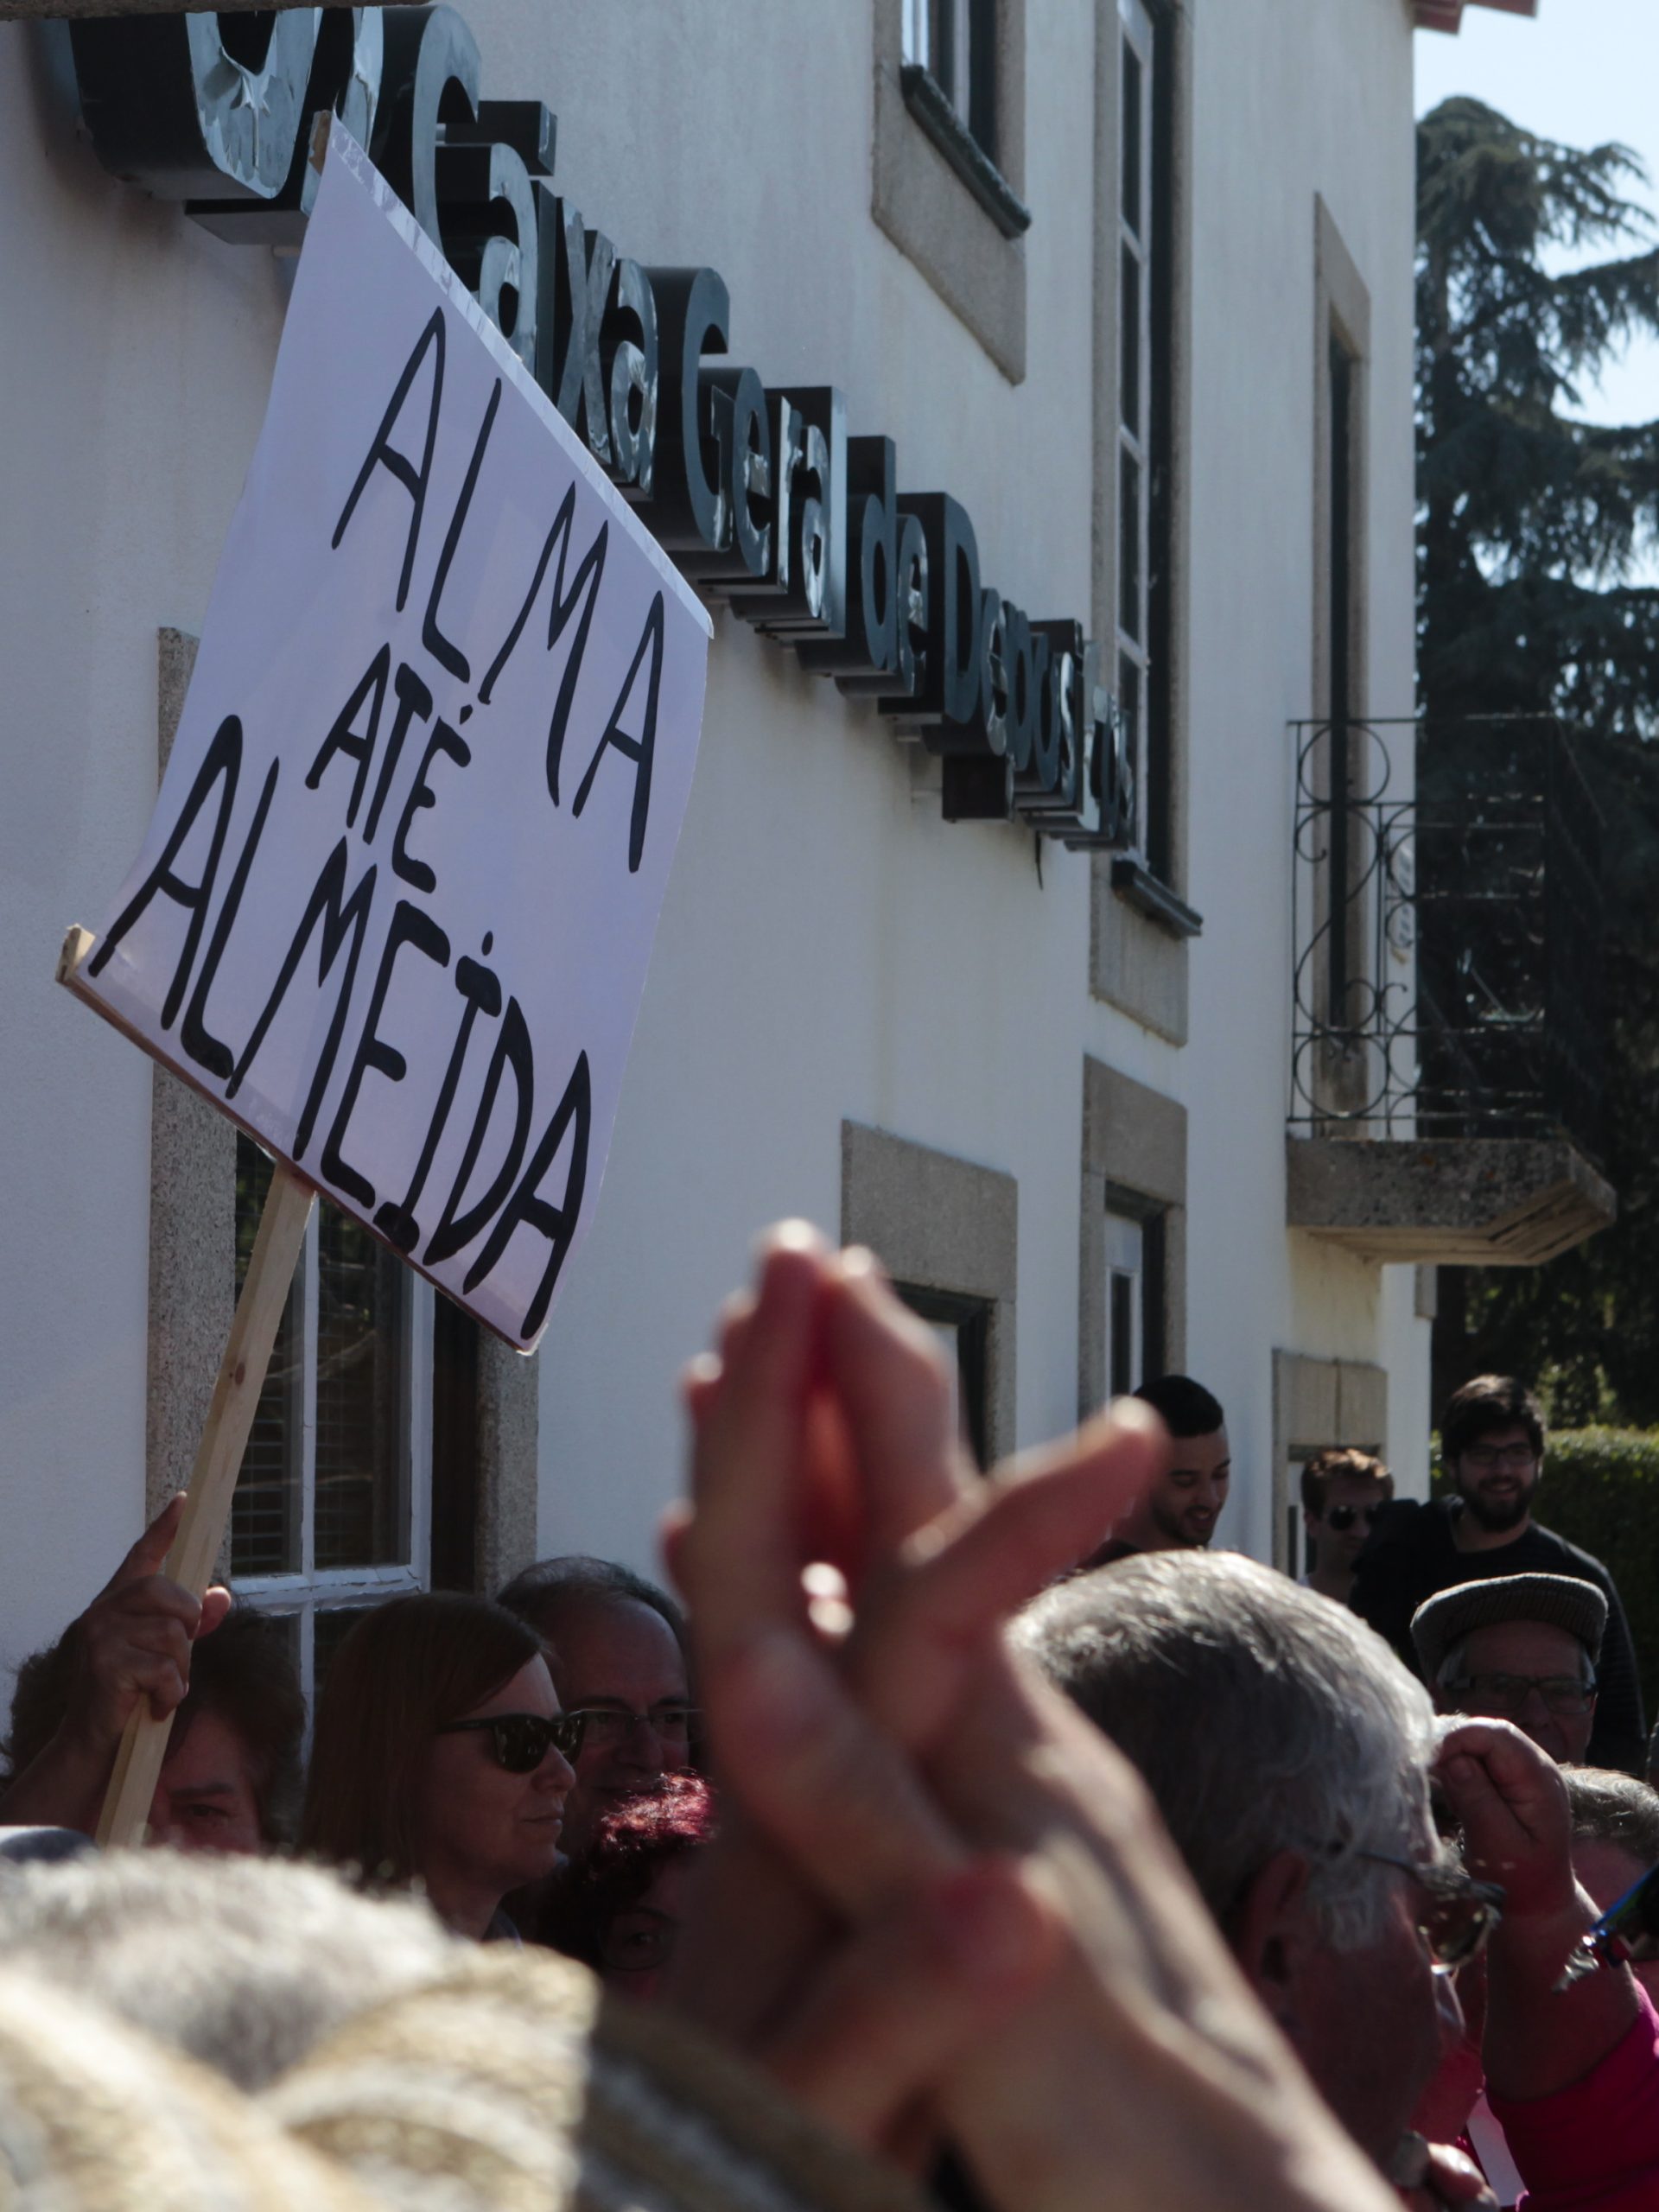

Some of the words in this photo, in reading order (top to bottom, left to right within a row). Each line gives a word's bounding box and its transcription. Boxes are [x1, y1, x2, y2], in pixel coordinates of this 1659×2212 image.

[330, 305, 665, 874] ALMA
[411, 4, 658, 499] Caixa
[681, 266, 849, 639] Geral
[861, 435, 929, 697] de
[87, 714, 592, 1338] ALMEIDA
[304, 642, 474, 894] ATÉ
